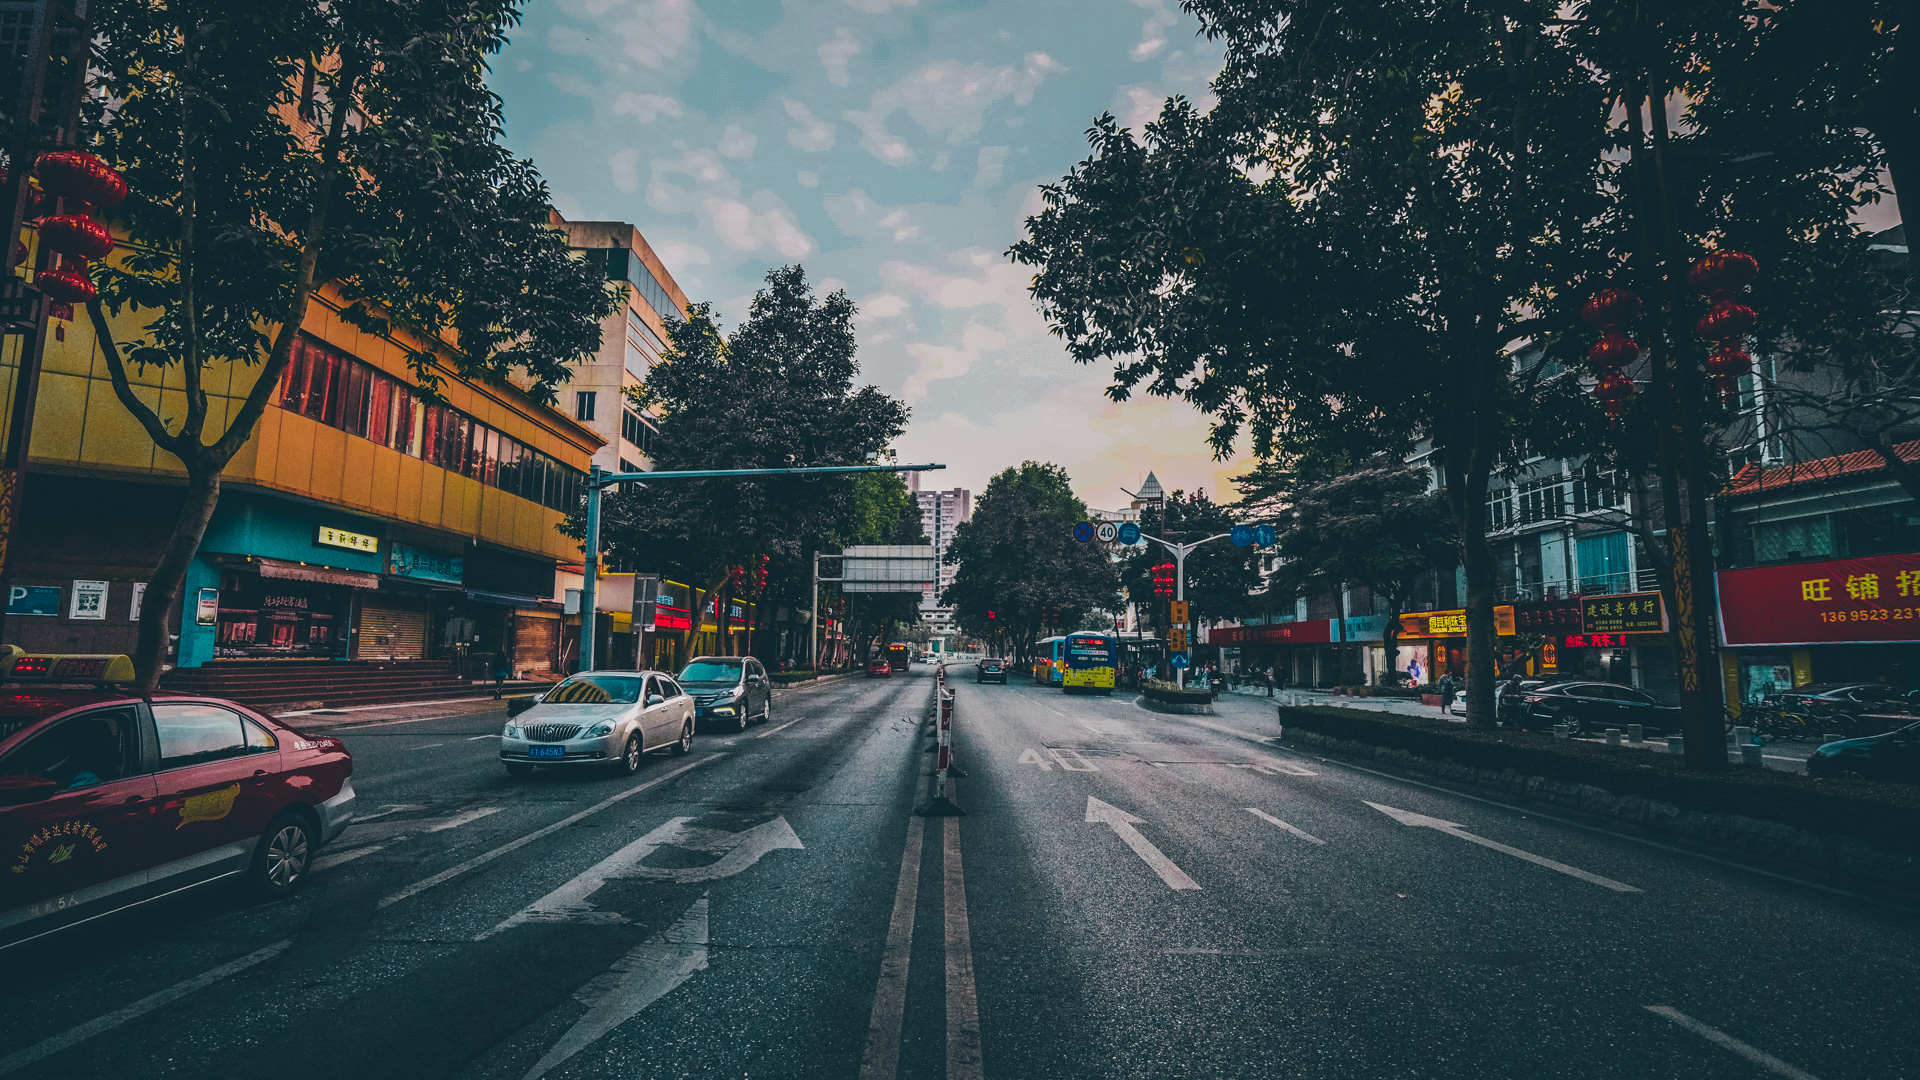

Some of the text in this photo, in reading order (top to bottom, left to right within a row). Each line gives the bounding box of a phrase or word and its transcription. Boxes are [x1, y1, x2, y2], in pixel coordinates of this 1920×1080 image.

[1100, 527, 1114, 538] 40
[9, 586, 27, 606] P
[1587, 600, 1656, 617] 建设寄售行
[1821, 611, 1847, 622] 136
[1850, 609, 1888, 621] 9523
[1018, 748, 1102, 772] 40
